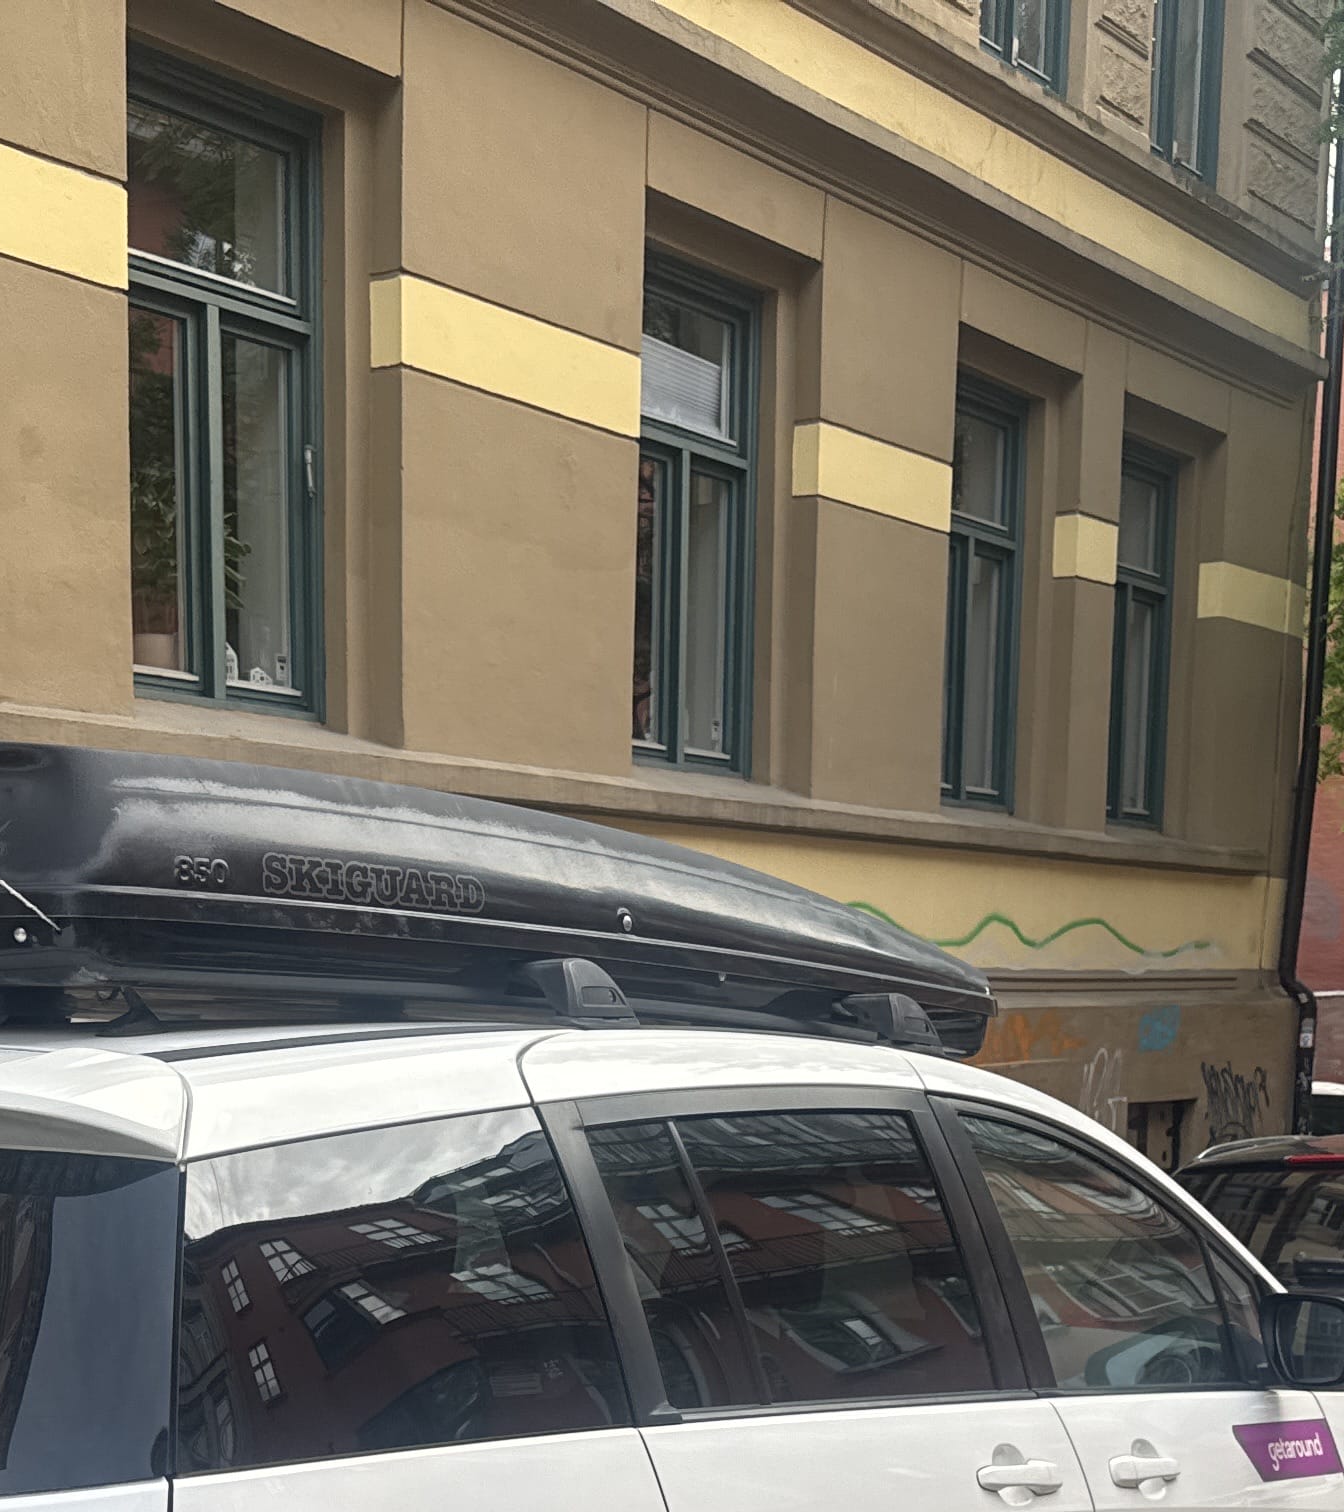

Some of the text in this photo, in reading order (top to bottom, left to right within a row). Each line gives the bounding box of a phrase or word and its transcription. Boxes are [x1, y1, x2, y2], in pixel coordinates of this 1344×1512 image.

[173, 852, 486, 913] 850 SKIGUARD
[1268, 1432, 1323, 1471] getaround
